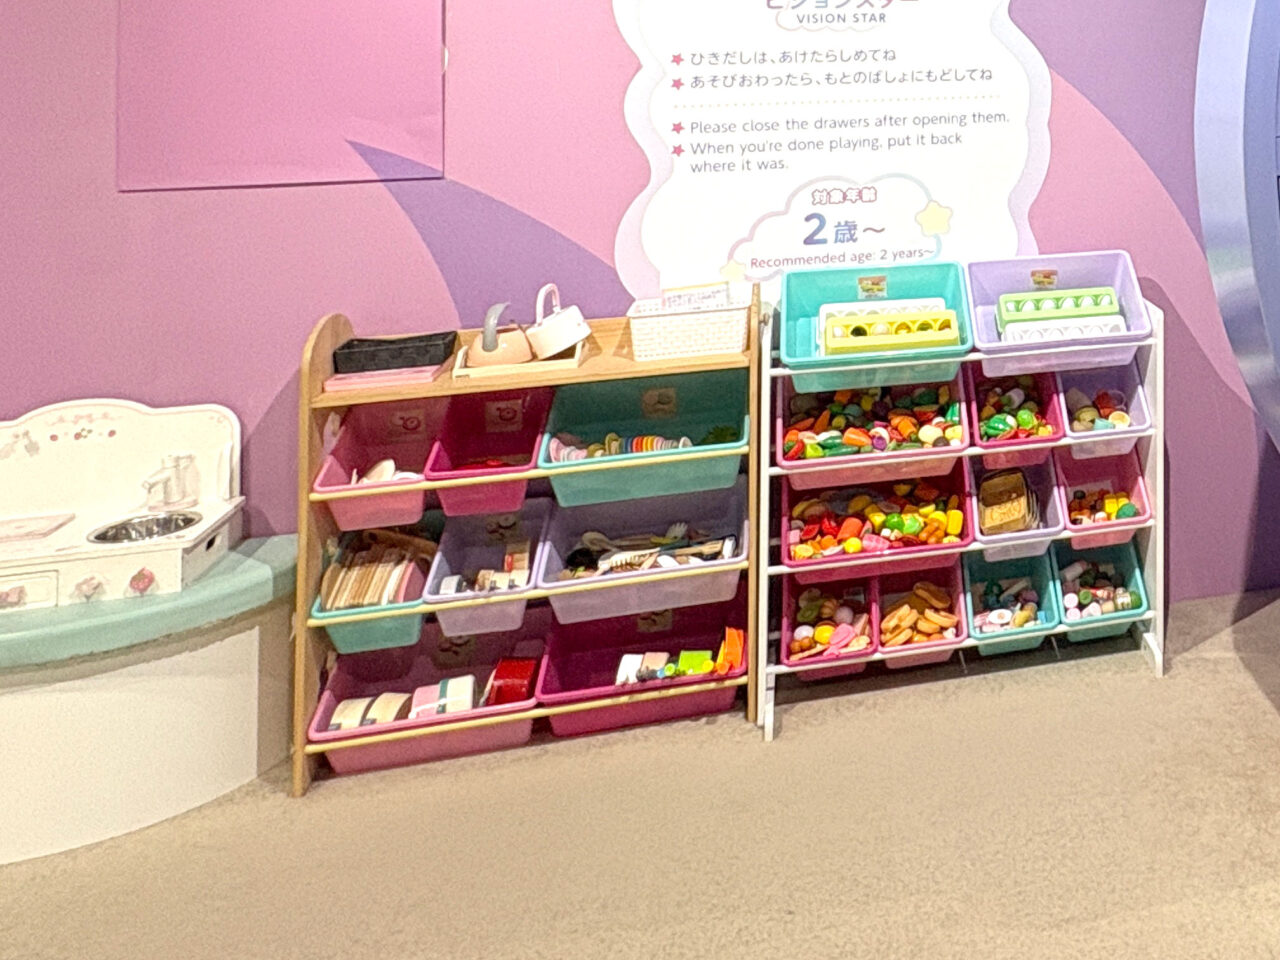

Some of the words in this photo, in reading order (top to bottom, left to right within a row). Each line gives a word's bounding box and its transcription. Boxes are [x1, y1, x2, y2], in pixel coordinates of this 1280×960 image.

[796, 13, 846, 24] VISION
[853, 12, 886, 23] STAR
[690, 49, 896, 66] ひきだしは、あけたらしめてね
[690, 121, 737, 134] Please
[742, 119, 780, 132] close
[786, 118, 809, 130] the
[814, 116, 870, 130] drawers
[875, 114, 908, 127] after
[912, 113, 967, 128] opening
[972, 111, 1010, 124] them.
[690, 141, 734, 155] When
[739, 140, 782, 156] you're
[787, 139, 824, 152] done
[887, 134, 911, 150] put
[916, 133, 926, 146] it
[931, 132, 963, 145] back
[690, 160, 736, 173] where
[741, 158, 751, 171] it
[757, 158, 789, 170] was.
[811, 186, 877, 205] 対象年齢
[750, 252, 846, 268] Recommended
[850, 252, 876, 264] age:
[879, 249, 888, 260] 2
